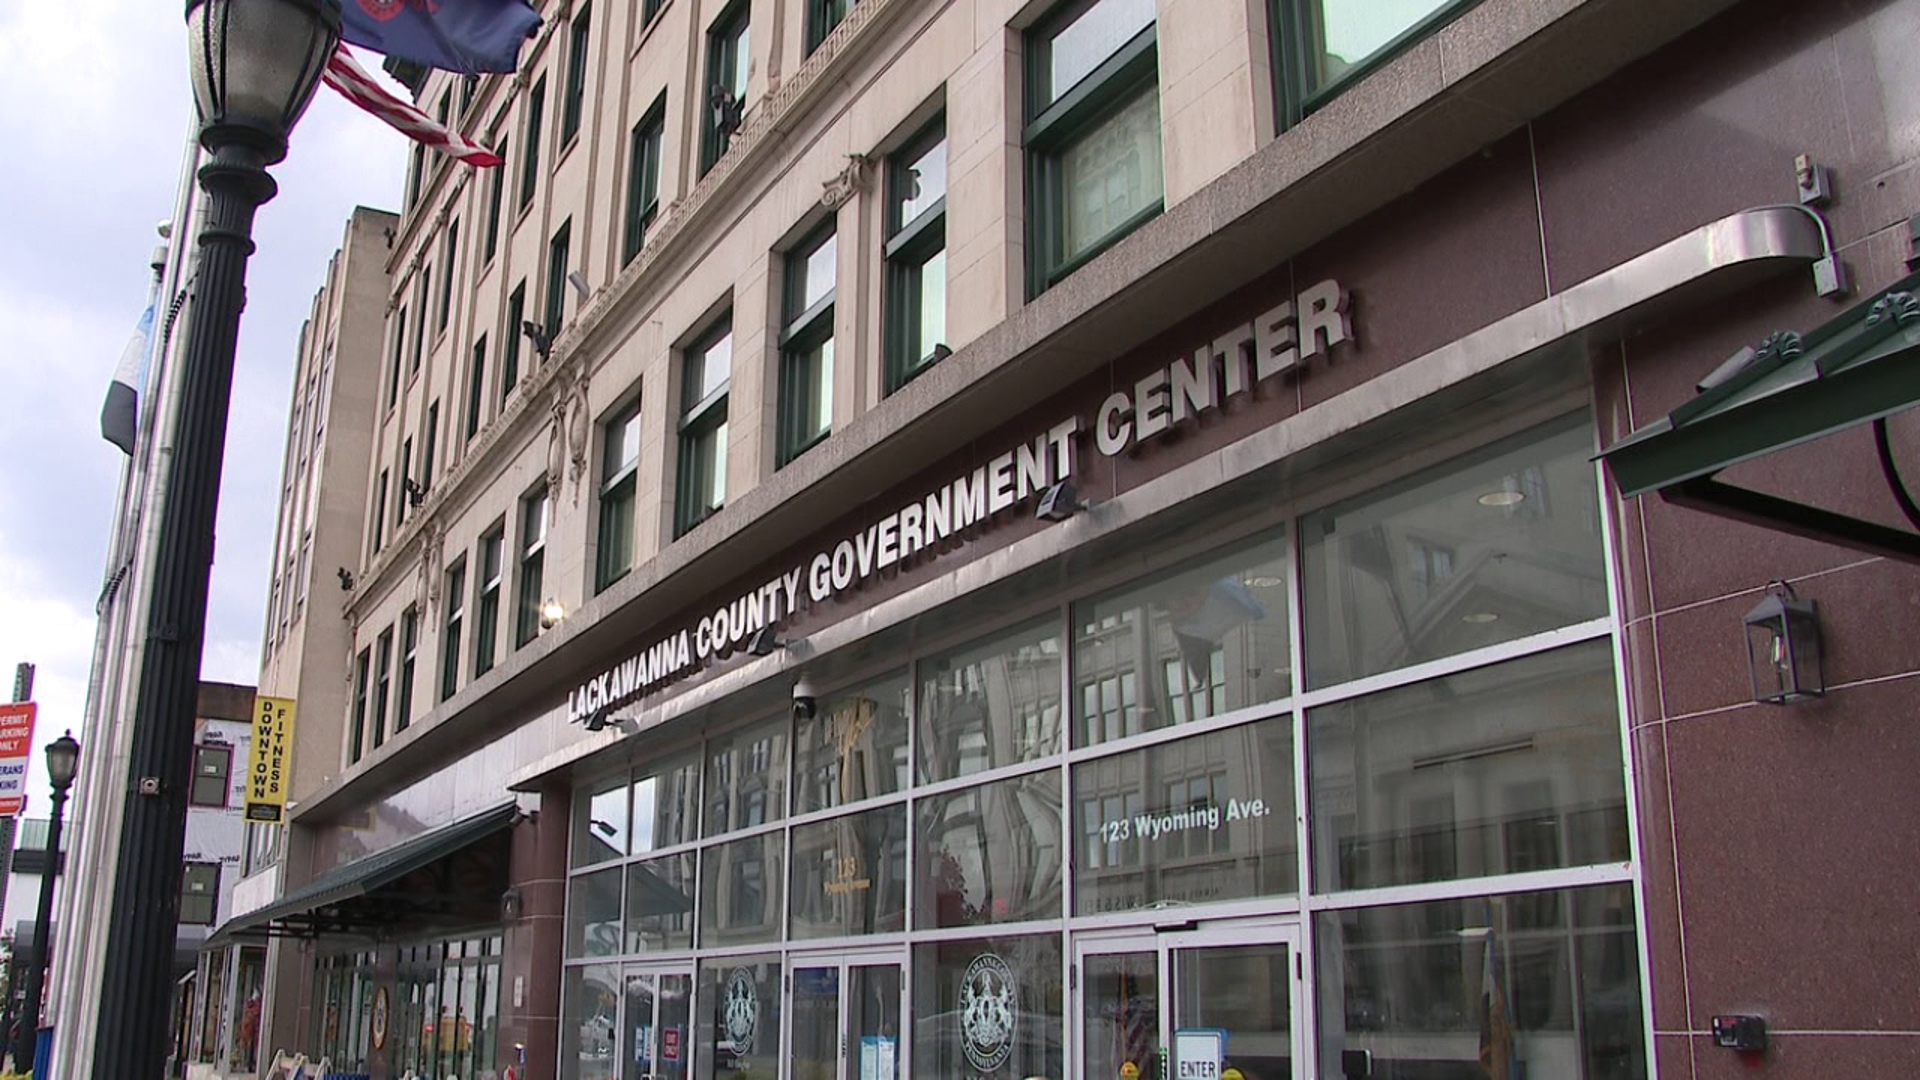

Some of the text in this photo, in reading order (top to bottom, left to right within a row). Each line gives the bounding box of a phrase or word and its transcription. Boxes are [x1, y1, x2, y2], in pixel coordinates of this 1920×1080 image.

[567, 278, 1351, 723] LACKAWANNA COUNTY GOVERNMENT CENTER
[253, 701, 273, 798] DOWNTOWN
[270, 709, 286, 793] FITNESS
[1100, 798, 1271, 844] 123 Wyoming Ave.
[1180, 1060, 1216, 1078] ENTER
